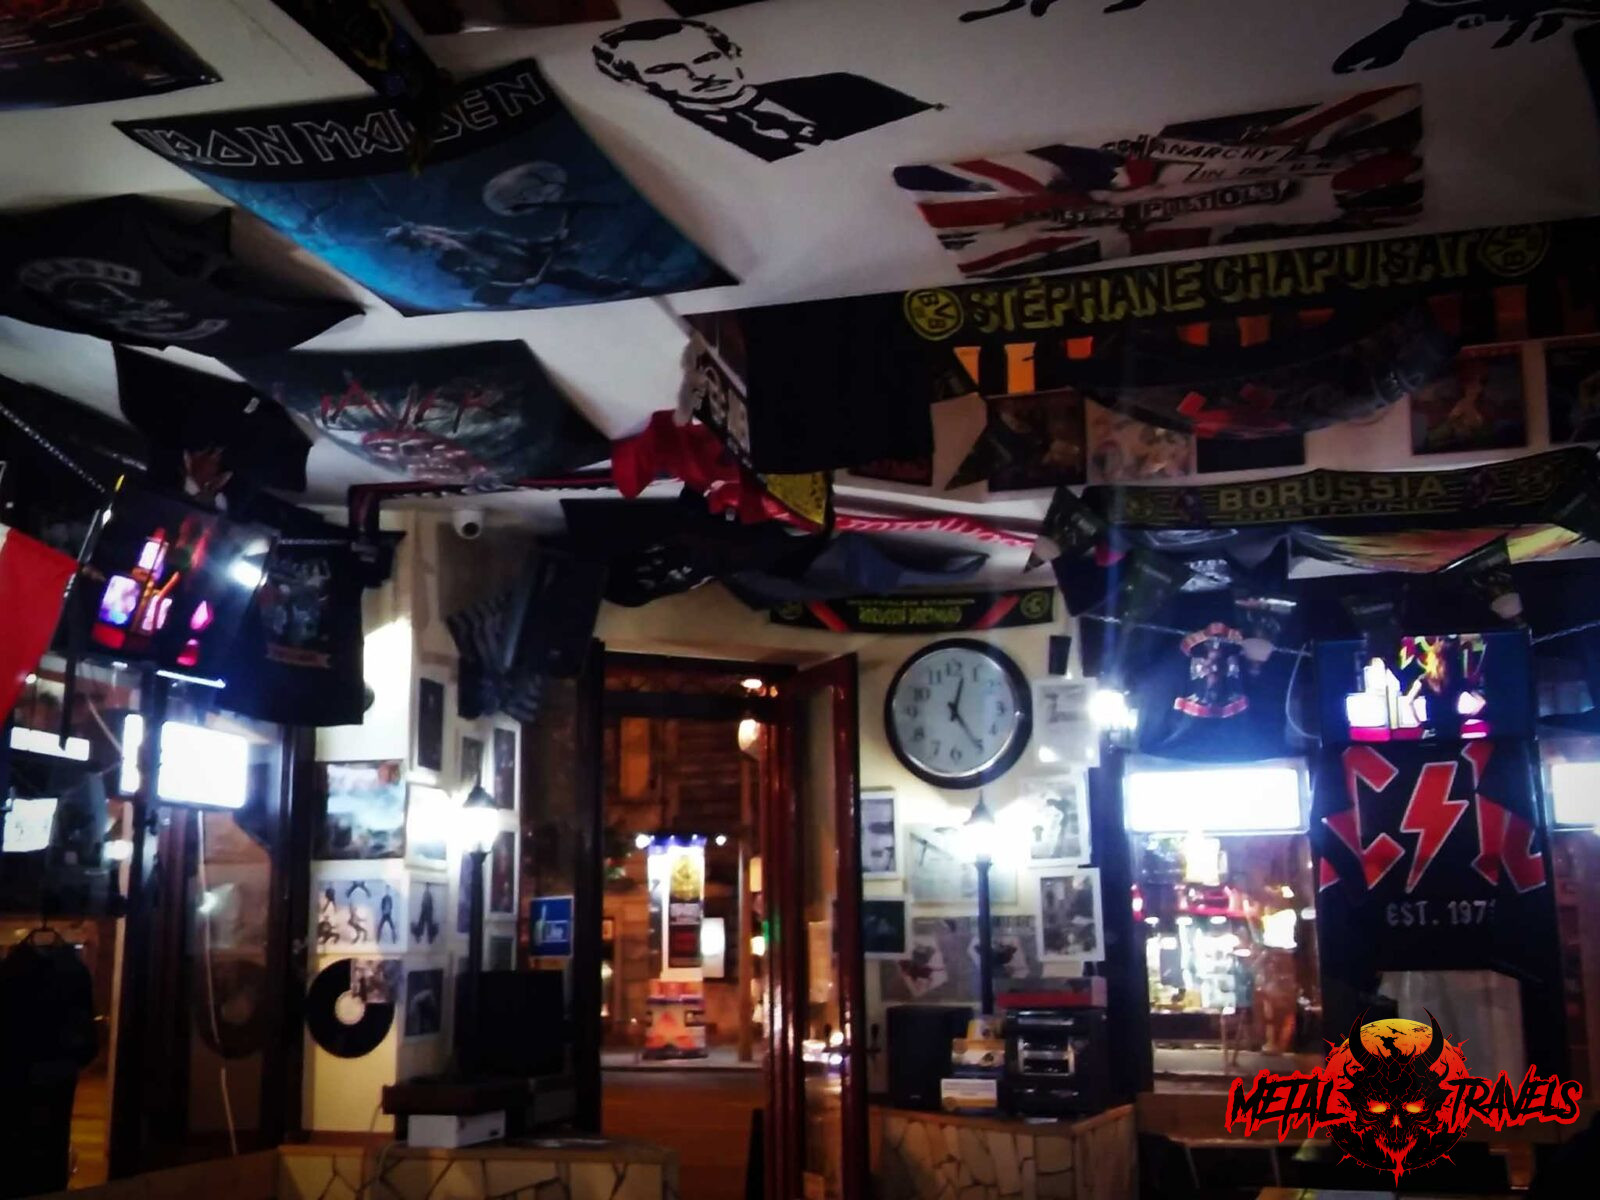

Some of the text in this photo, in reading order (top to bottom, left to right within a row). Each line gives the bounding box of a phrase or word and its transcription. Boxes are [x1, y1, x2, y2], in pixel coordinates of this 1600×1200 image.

[133, 122, 304, 168] IRON
[1219, 475, 1447, 512] BORUSSIA
[1386, 899, 1440, 927] EST.
